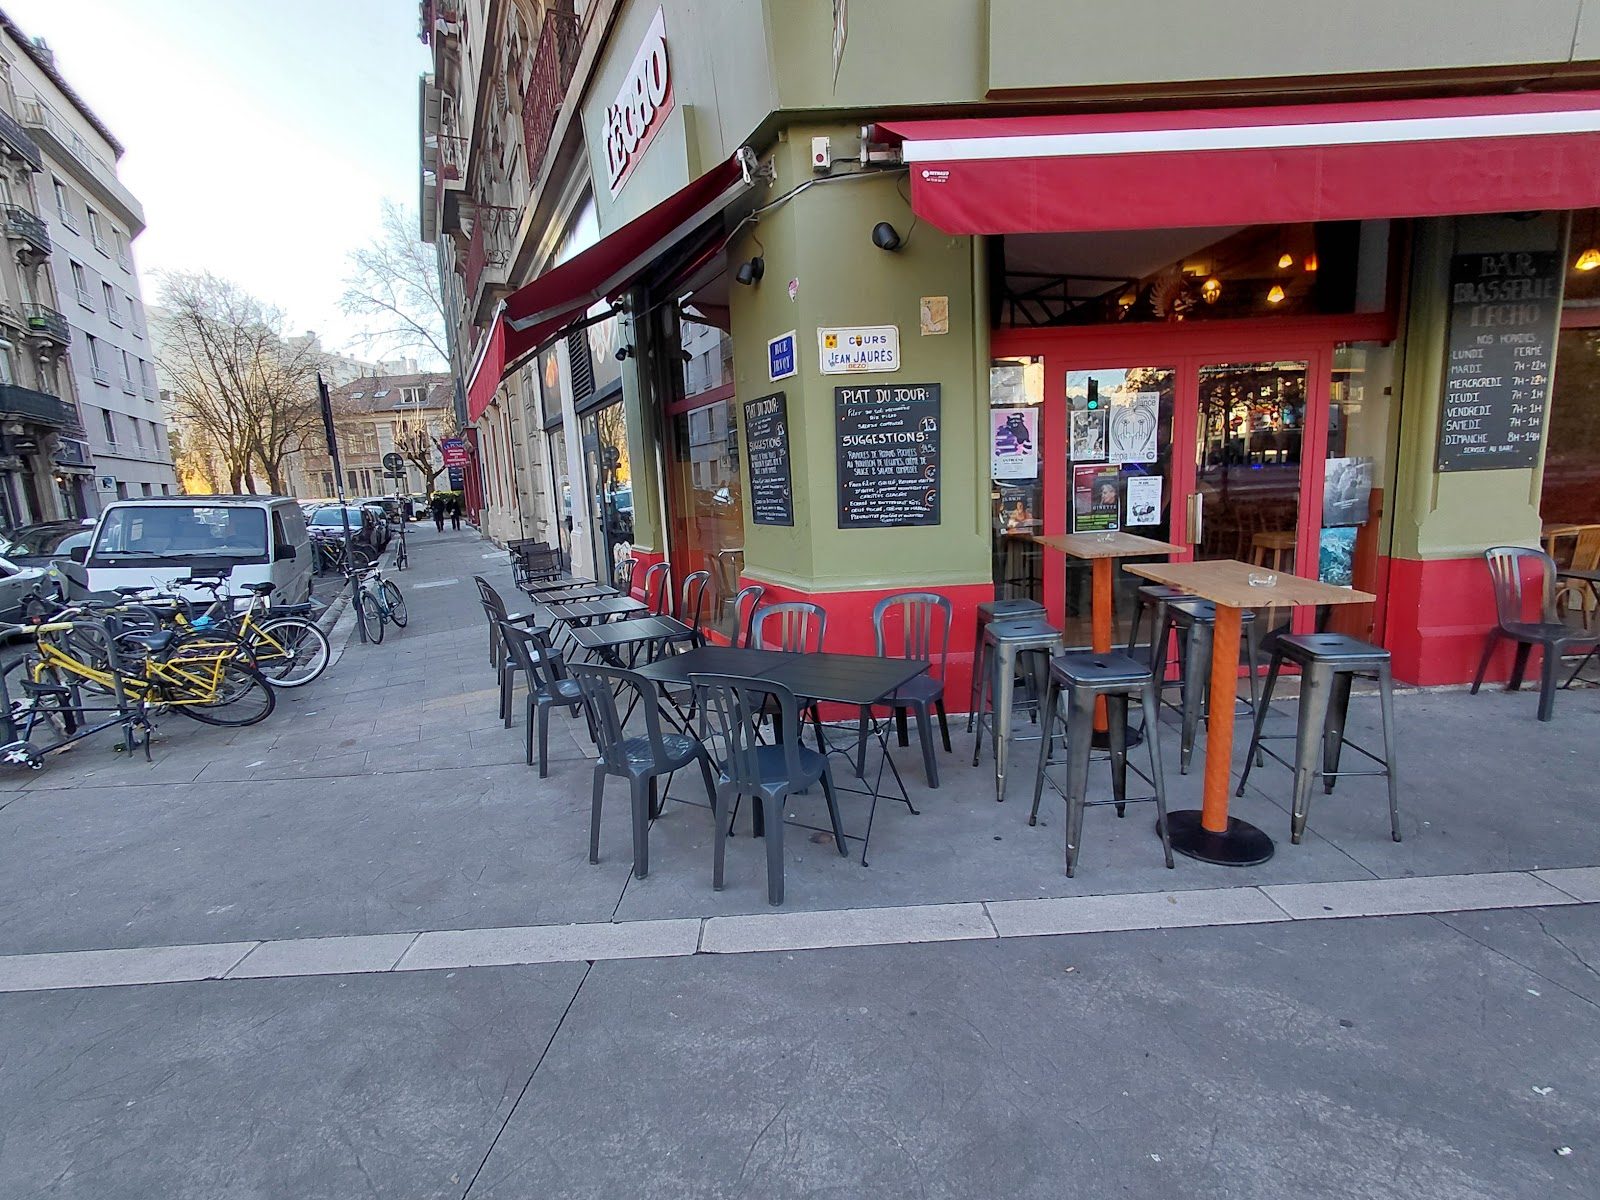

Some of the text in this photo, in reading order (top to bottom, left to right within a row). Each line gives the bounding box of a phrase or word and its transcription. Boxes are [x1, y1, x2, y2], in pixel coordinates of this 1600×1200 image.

[1479, 253, 1536, 277] BAR
[1453, 278, 1554, 303] BRASSERIE
[848, 335, 887, 346] CURS
[1476, 334, 1494, 344] NOS
[774, 340, 788, 356] RUE
[1452, 348, 1484, 360] LUNDI
[829, 352, 850, 364] JEAN
[1451, 364, 1482, 374] MARDI
[842, 388, 930, 404] PLAT DU JOUR:
[1449, 392, 1480, 404] JEUDI
[1446, 404, 1492, 418] VENDREDI
[922, 418, 937, 432] 13
[1446, 418, 1482, 432] SAMEDI
[842, 432, 929, 446] SUGGESTIONS:
[1445, 433, 1488, 445] DIMANCHE
